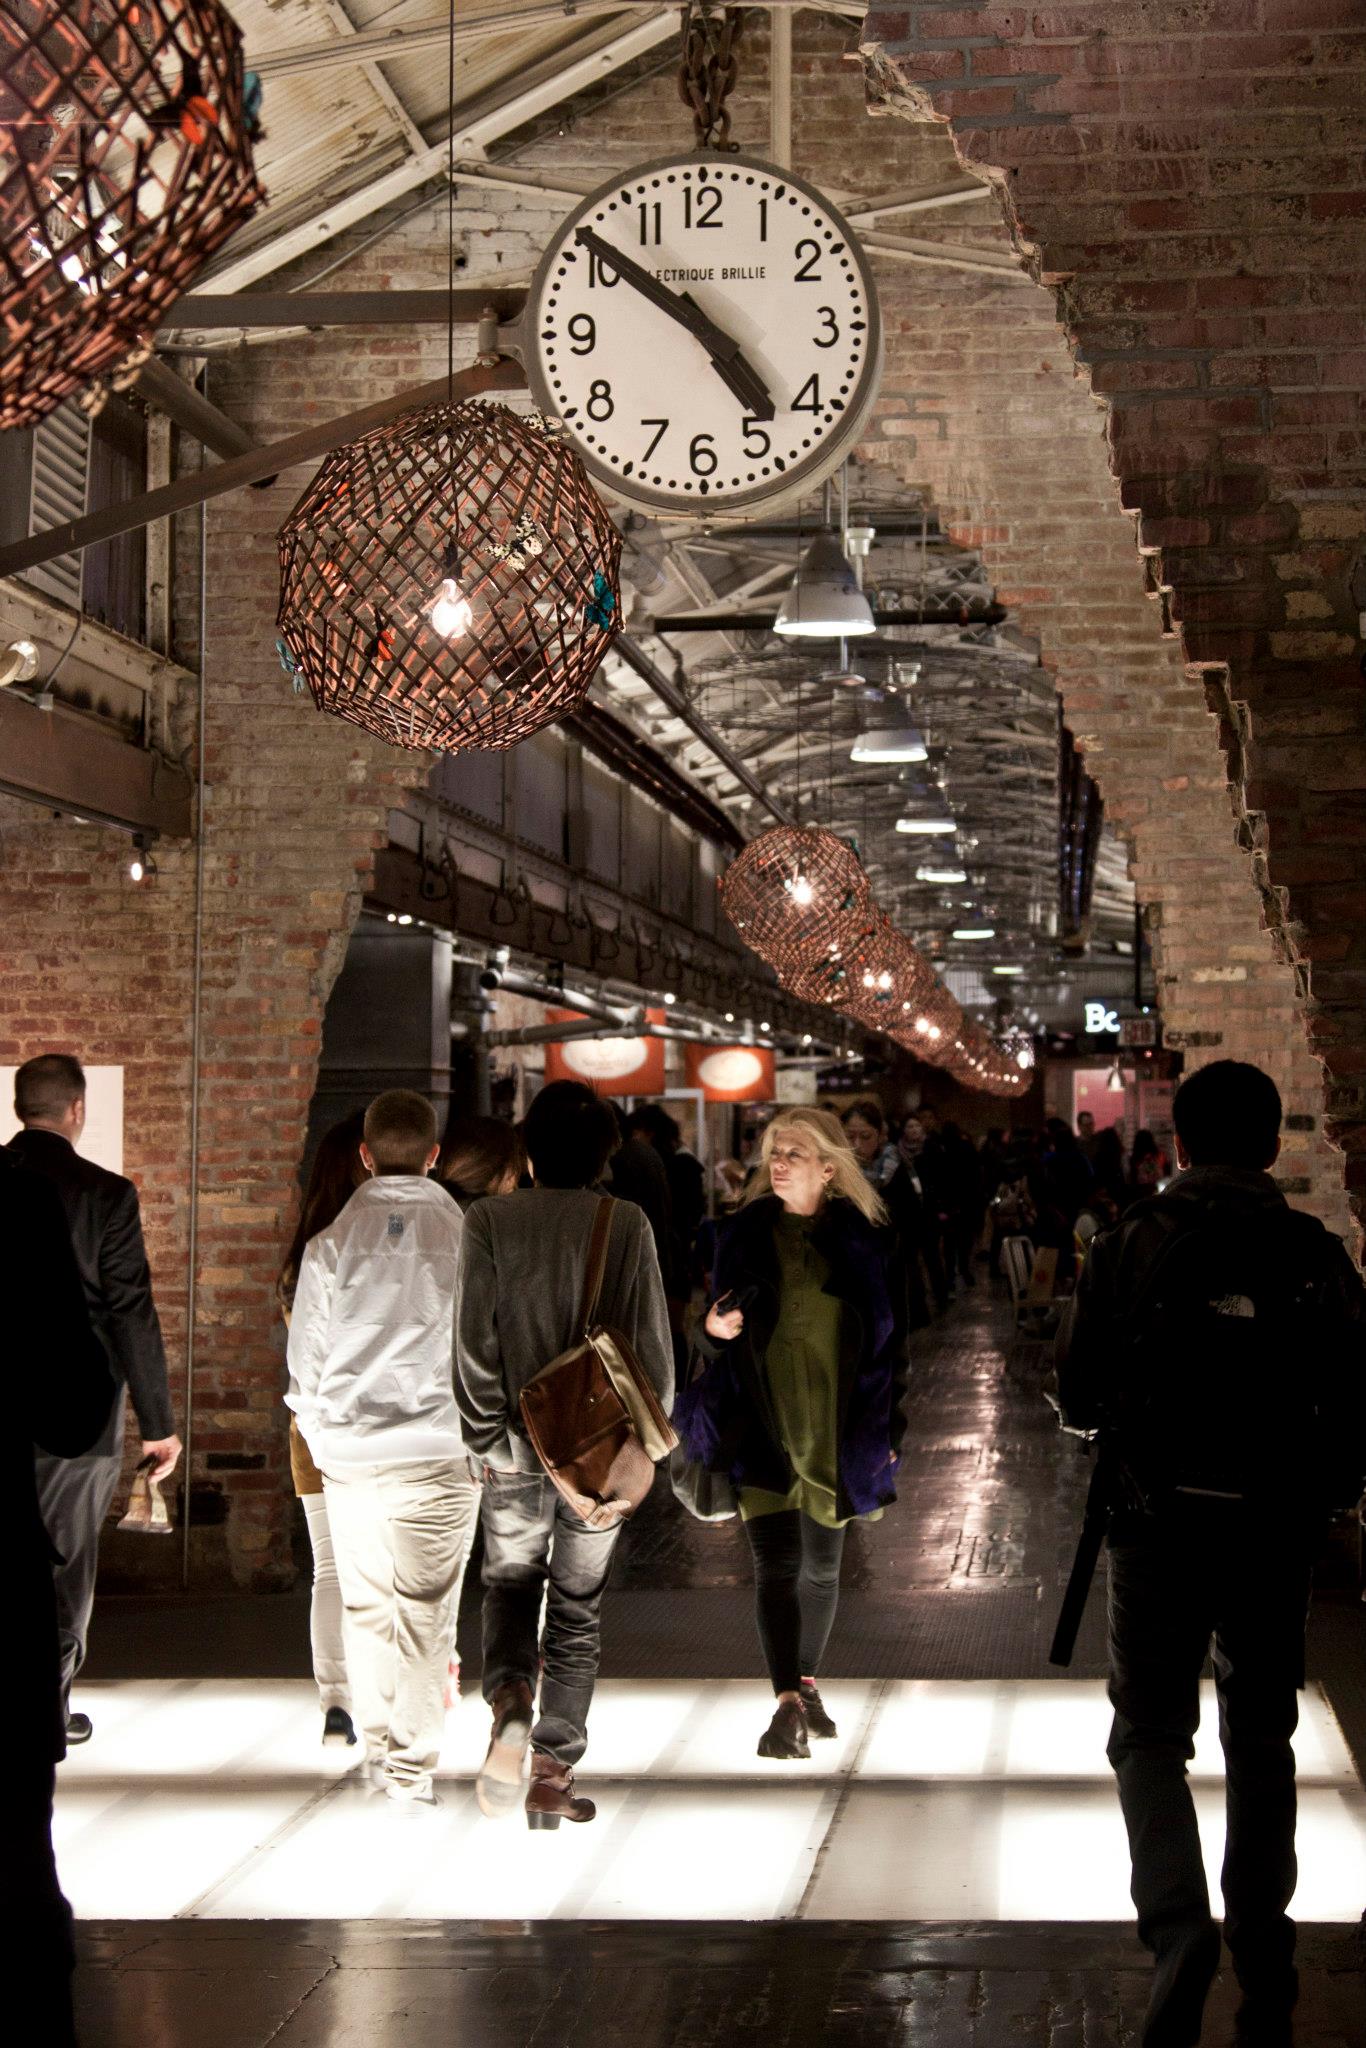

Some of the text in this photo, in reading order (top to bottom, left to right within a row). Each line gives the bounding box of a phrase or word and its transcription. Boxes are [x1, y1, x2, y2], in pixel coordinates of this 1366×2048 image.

[637, 201, 662, 246] 11
[682, 185, 724, 229] 12
[757, 198, 768, 242] 1
[586, 247, 622, 288] 10
[721, 267, 766, 280] BRILLIE
[793, 238, 822, 283] 2
[567, 313, 596, 356] 9
[812, 305, 840, 349] 3
[586, 379, 615, 423] 8
[790, 373, 825, 416] 4
[640, 418, 670, 463] 7
[689, 433, 718, 477] 6
[741, 416, 771, 459] 5
